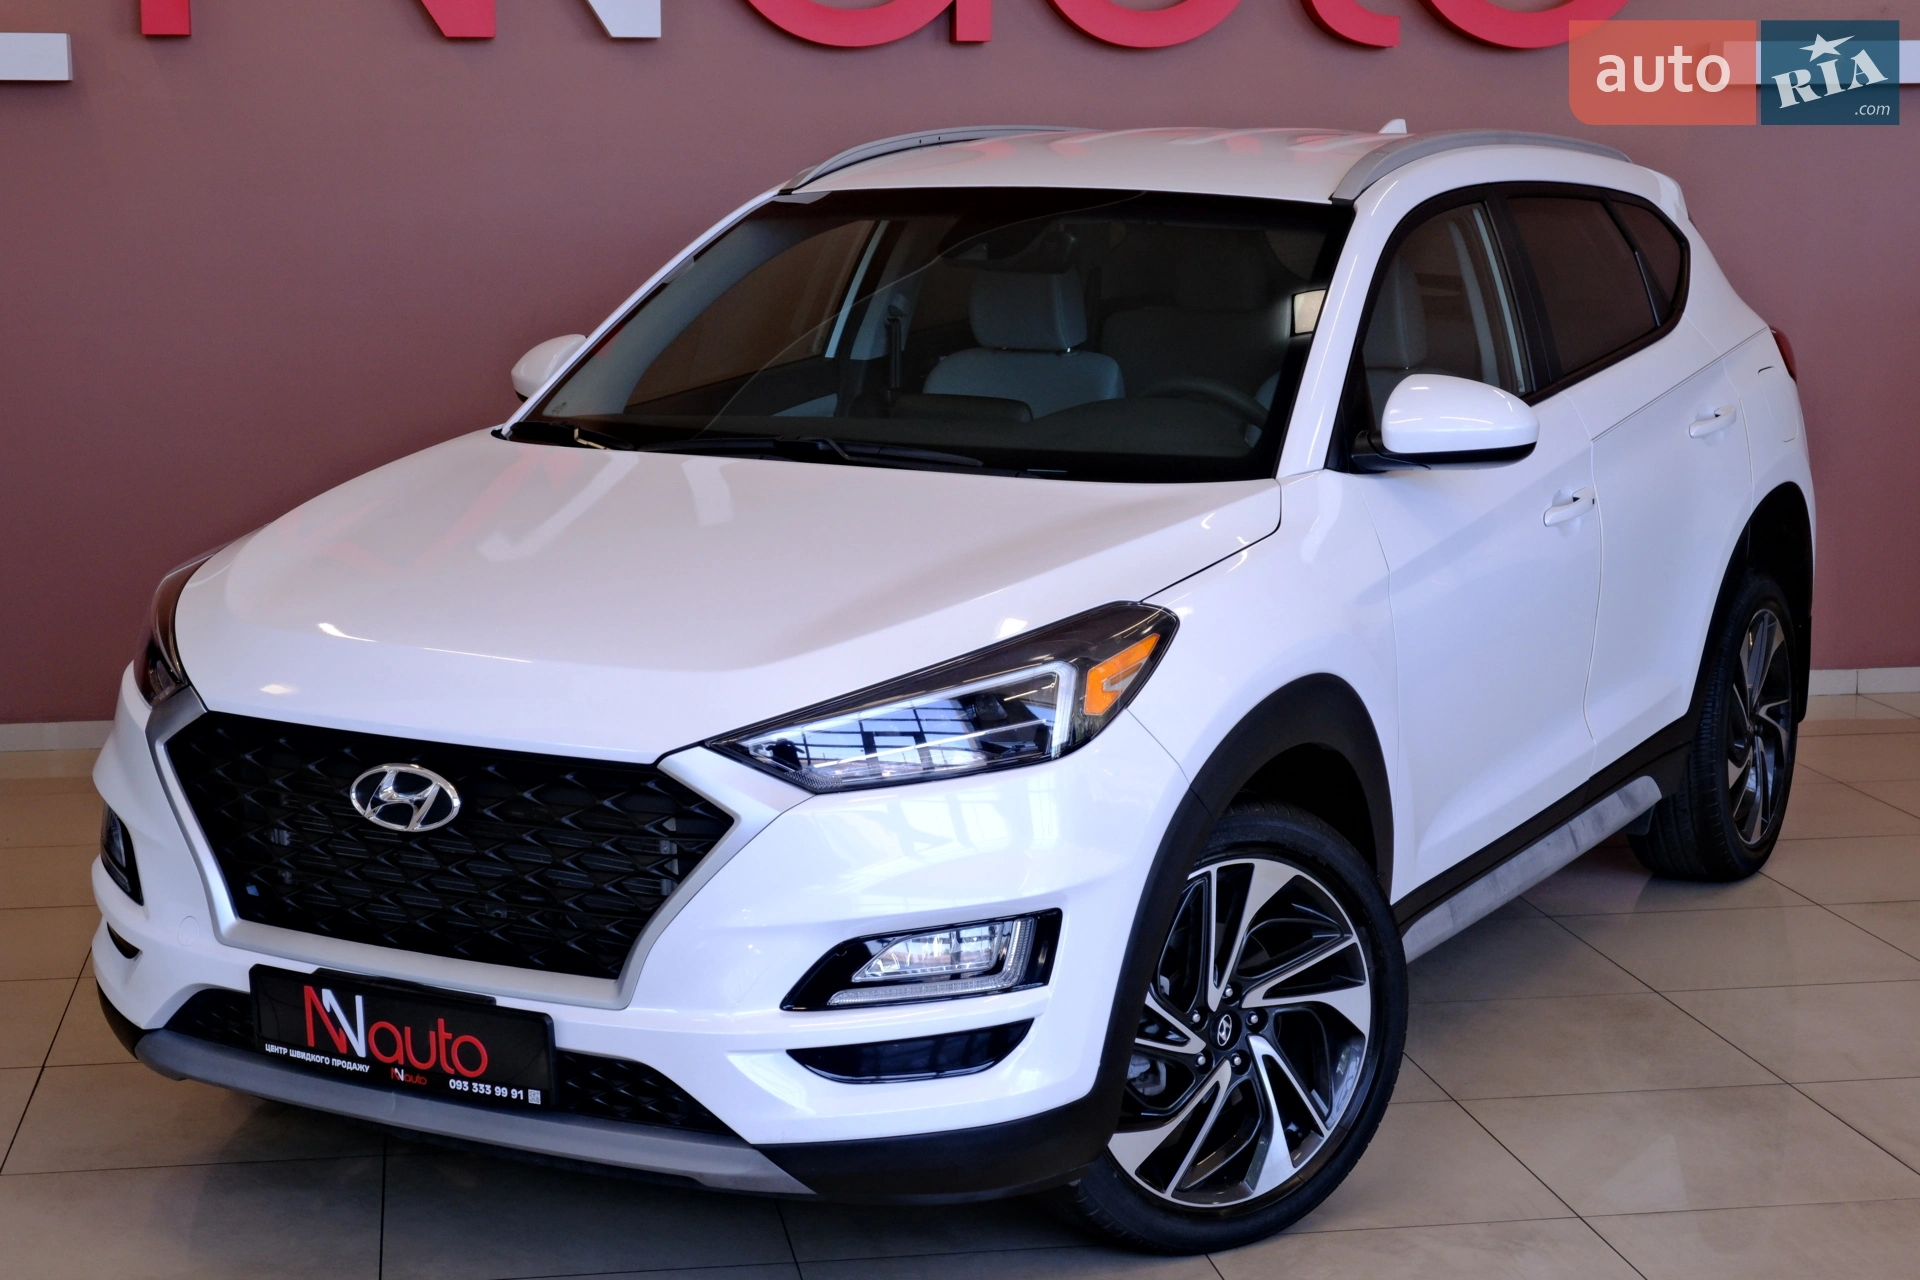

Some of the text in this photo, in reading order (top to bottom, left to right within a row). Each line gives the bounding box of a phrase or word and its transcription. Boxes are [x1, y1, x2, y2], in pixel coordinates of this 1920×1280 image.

[265, 1043, 370, 1073] ЦЕНТР ШВИДКОГО ПРОДАЖУ
[449, 1079, 523, 1100] 093 333 99 91
